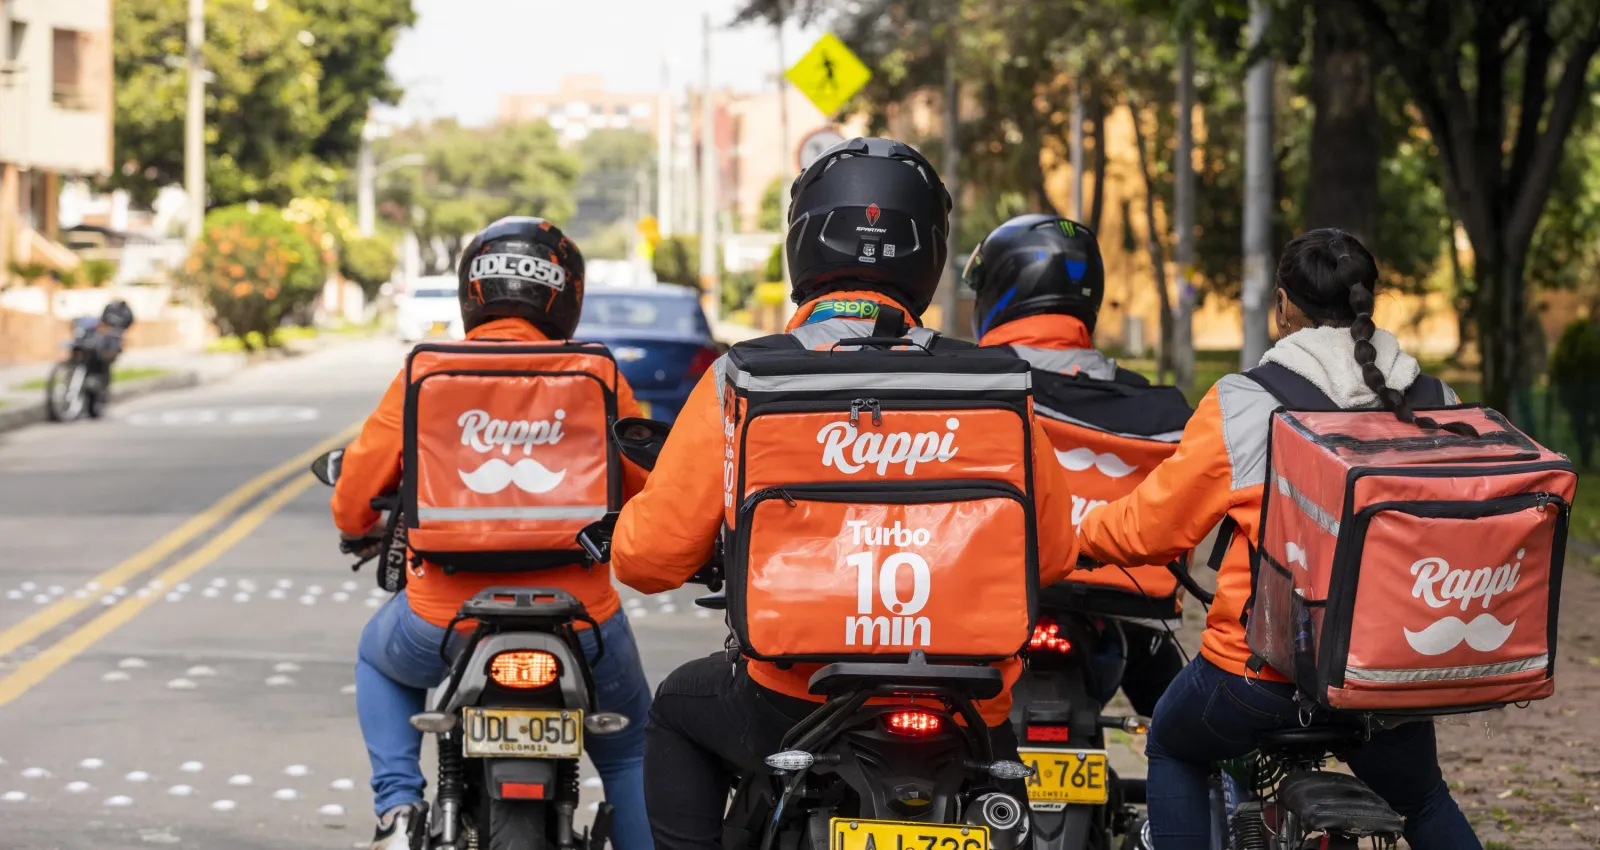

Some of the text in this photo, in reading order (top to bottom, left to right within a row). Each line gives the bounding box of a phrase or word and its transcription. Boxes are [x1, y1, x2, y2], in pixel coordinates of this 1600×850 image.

[471, 255, 565, 286] UDL-05D
[457, 408, 565, 456] Rappi
[817, 417, 960, 476] Rappi
[846, 520, 931, 547] Turbo
[846, 551, 931, 615] 10
[1410, 548, 1525, 611] Rappi
[845, 615, 931, 646] min
[498, 743, 549, 752] COLOMBIA
